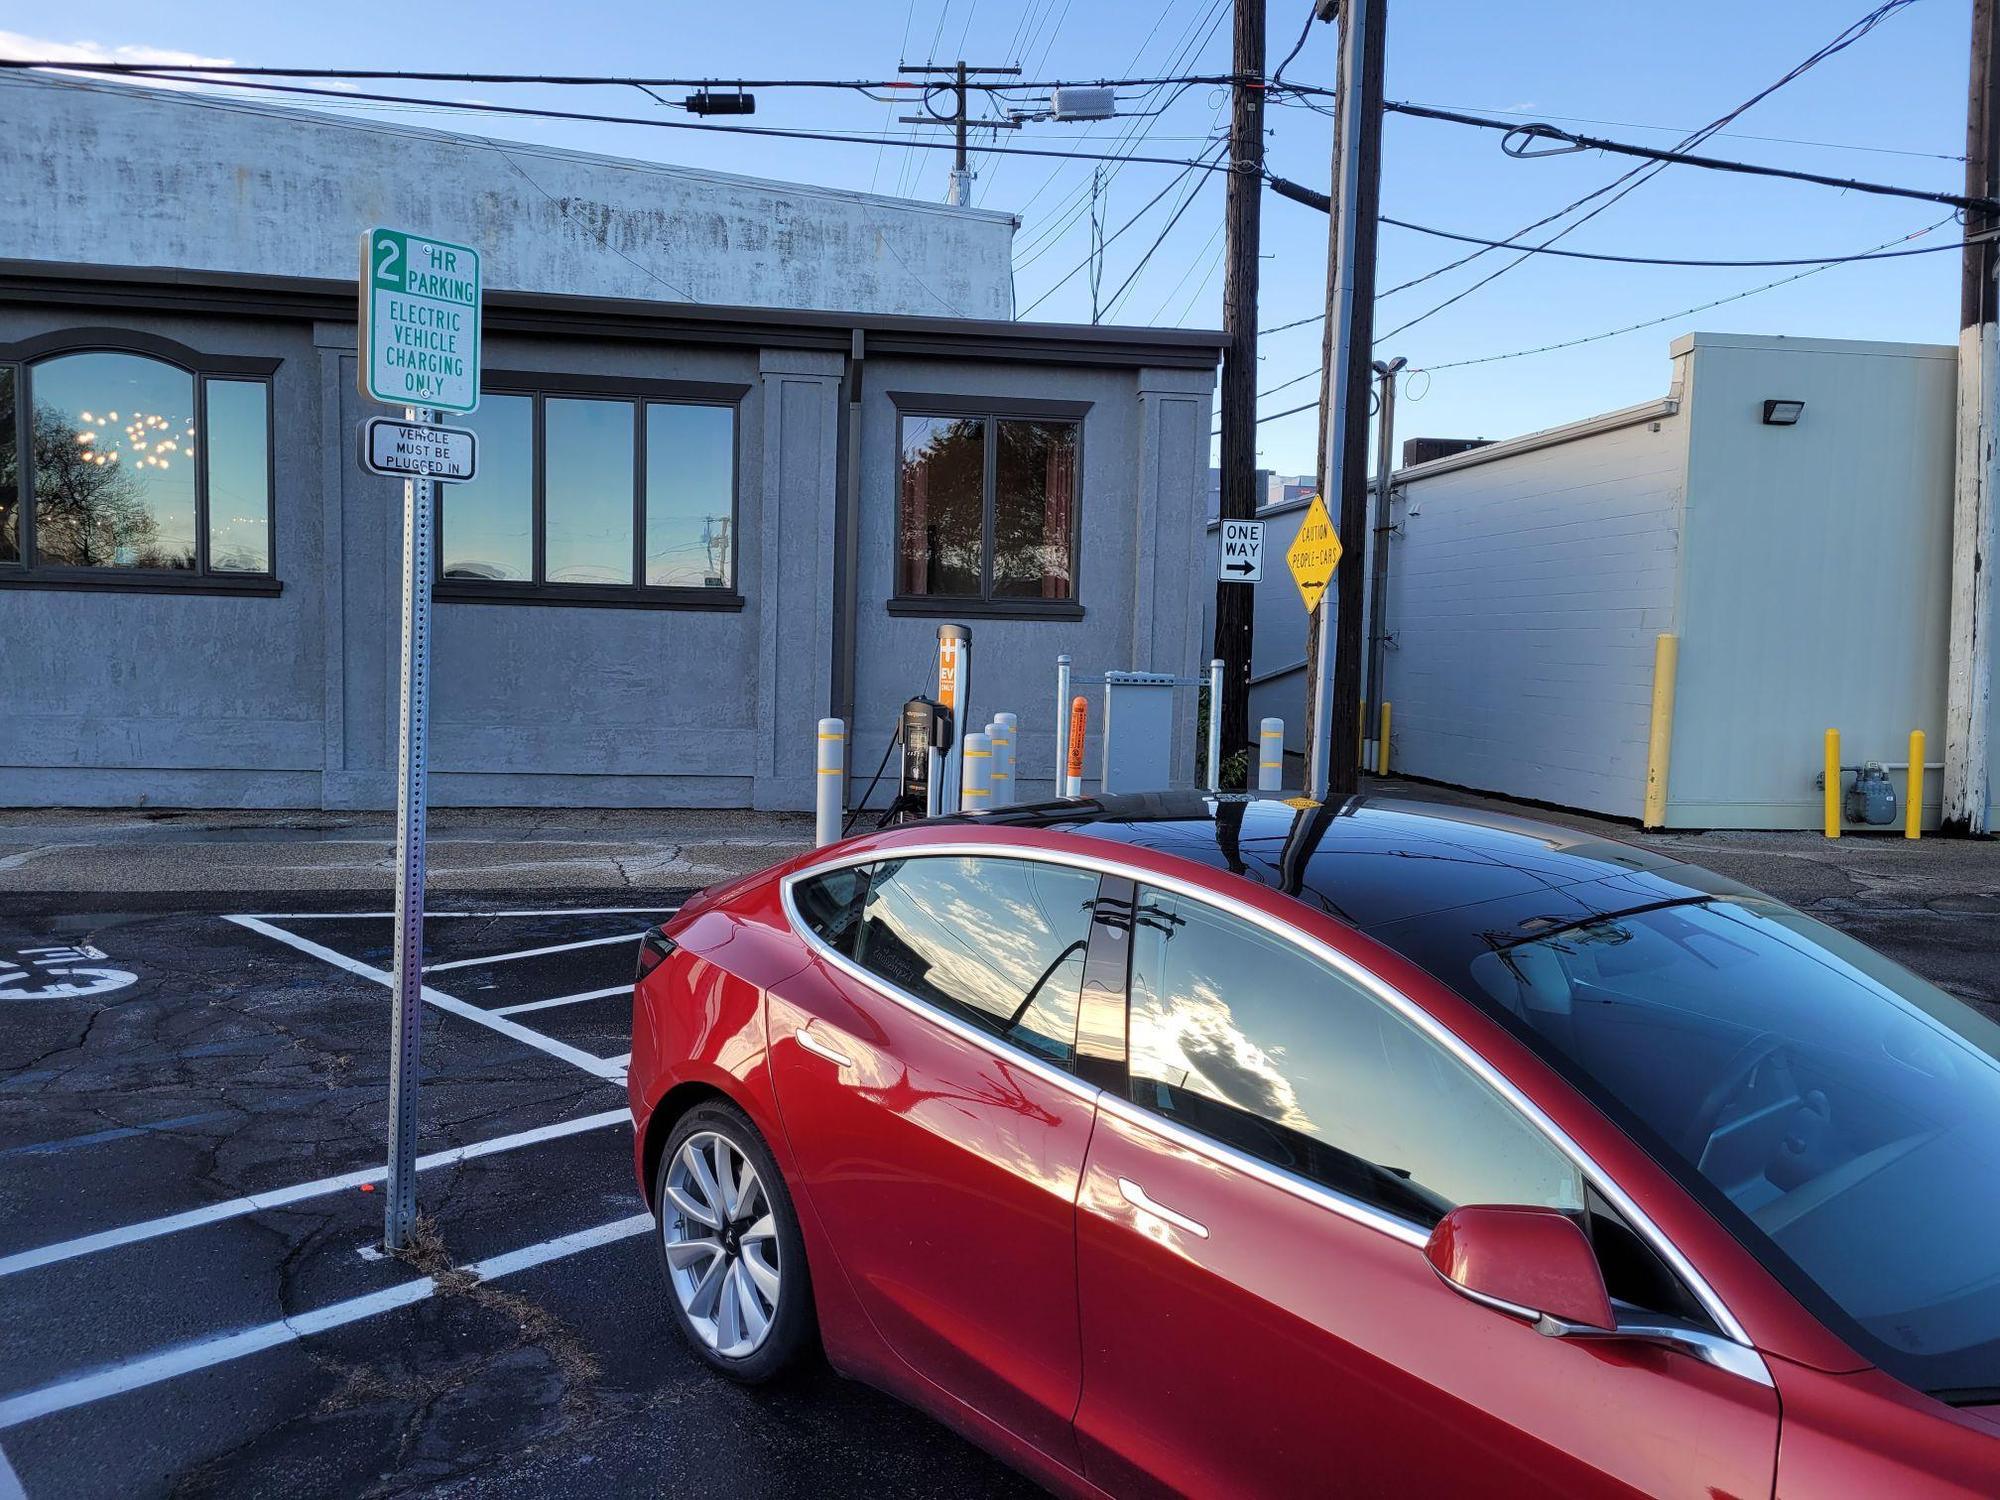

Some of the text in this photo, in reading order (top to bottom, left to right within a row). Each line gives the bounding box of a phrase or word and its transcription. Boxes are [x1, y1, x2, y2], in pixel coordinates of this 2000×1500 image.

[377, 239, 457, 282] 2 HR
[408, 270, 474, 303] PARKING
[390, 301, 461, 332] ELECTRIC
[394, 325, 457, 354] VEHICLE
[386, 347, 463, 377] CHARGING
[405, 372, 444, 396] ONLY
[396, 442, 450, 459] MUST BE
[448, 463, 460, 474] IN
[1226, 525, 1259, 540] ONE
[1302, 523, 1327, 543] CAUTION
[1225, 543, 1259, 557] WAY
[941, 667, 954, 679] EV
